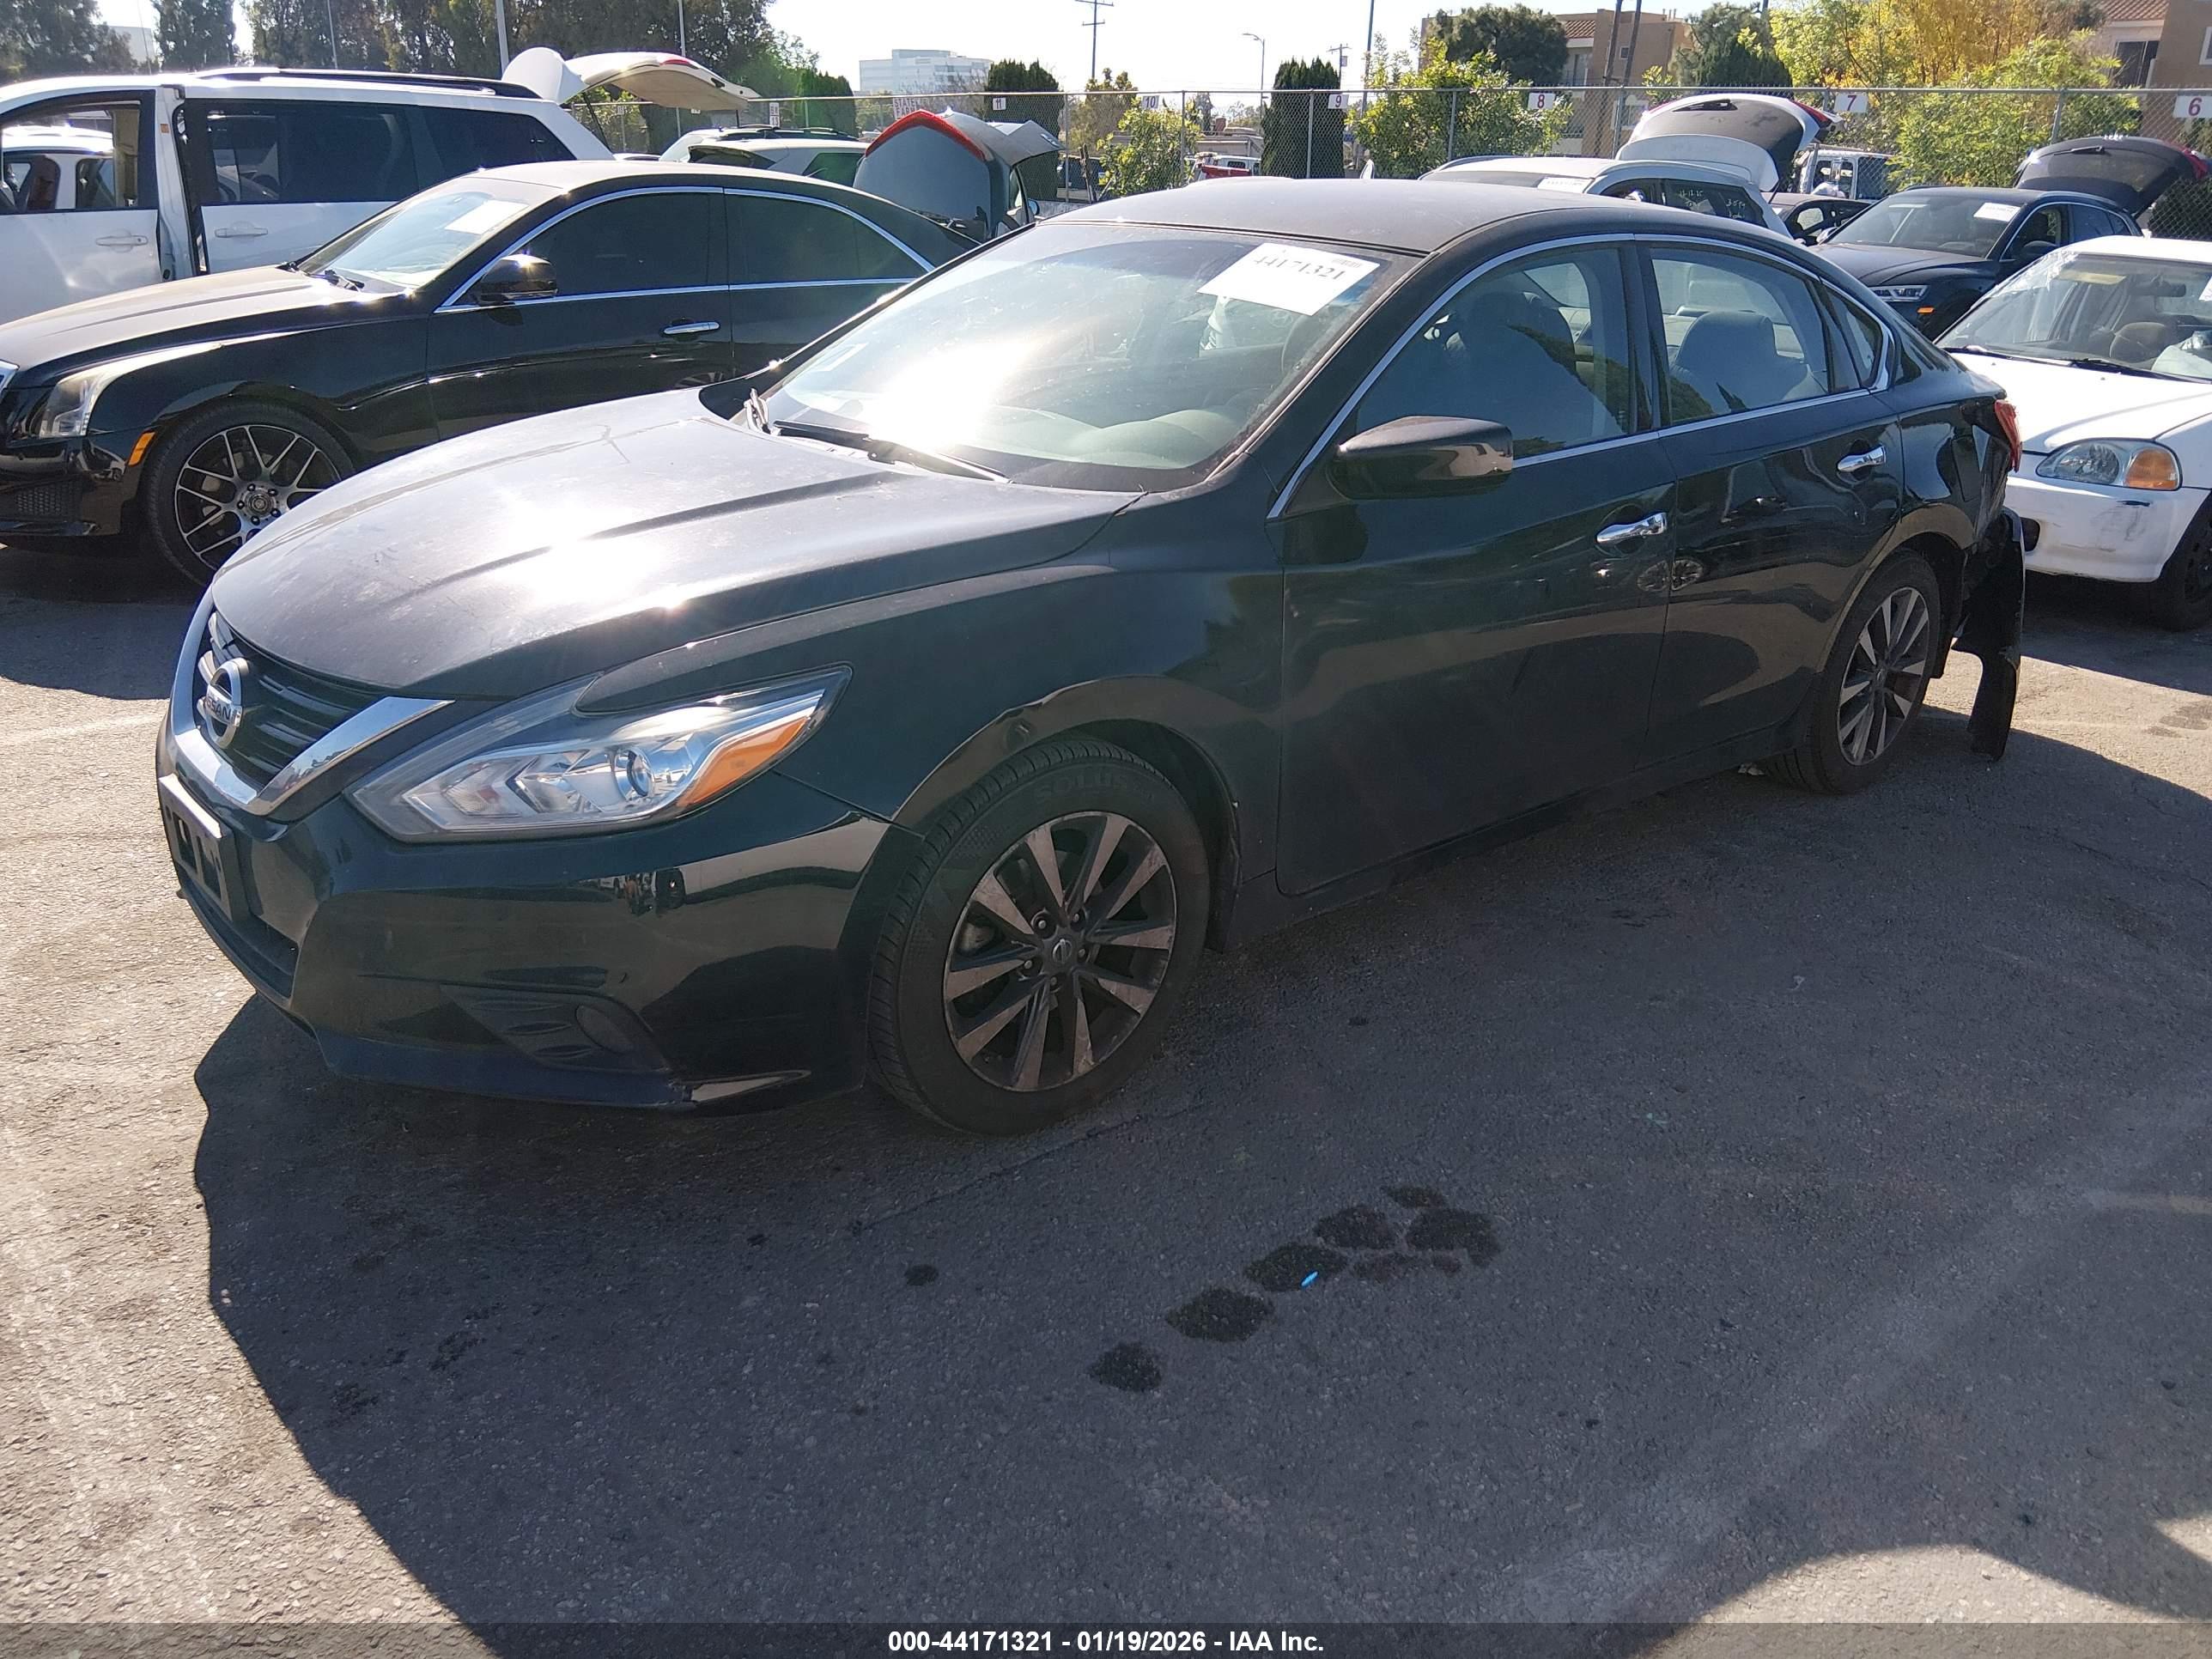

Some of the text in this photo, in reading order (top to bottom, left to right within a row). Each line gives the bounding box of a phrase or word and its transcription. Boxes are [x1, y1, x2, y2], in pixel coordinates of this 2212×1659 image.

[995, 98, 1002, 110] 11
[1146, 95, 1156, 108] 10
[1335, 94, 1341, 108] 9
[1538, 94, 1545, 108] 8
[1847, 94, 1856, 112] 7
[2189, 97, 2202, 116] 6
[203, 696, 232, 720] ISSAN
